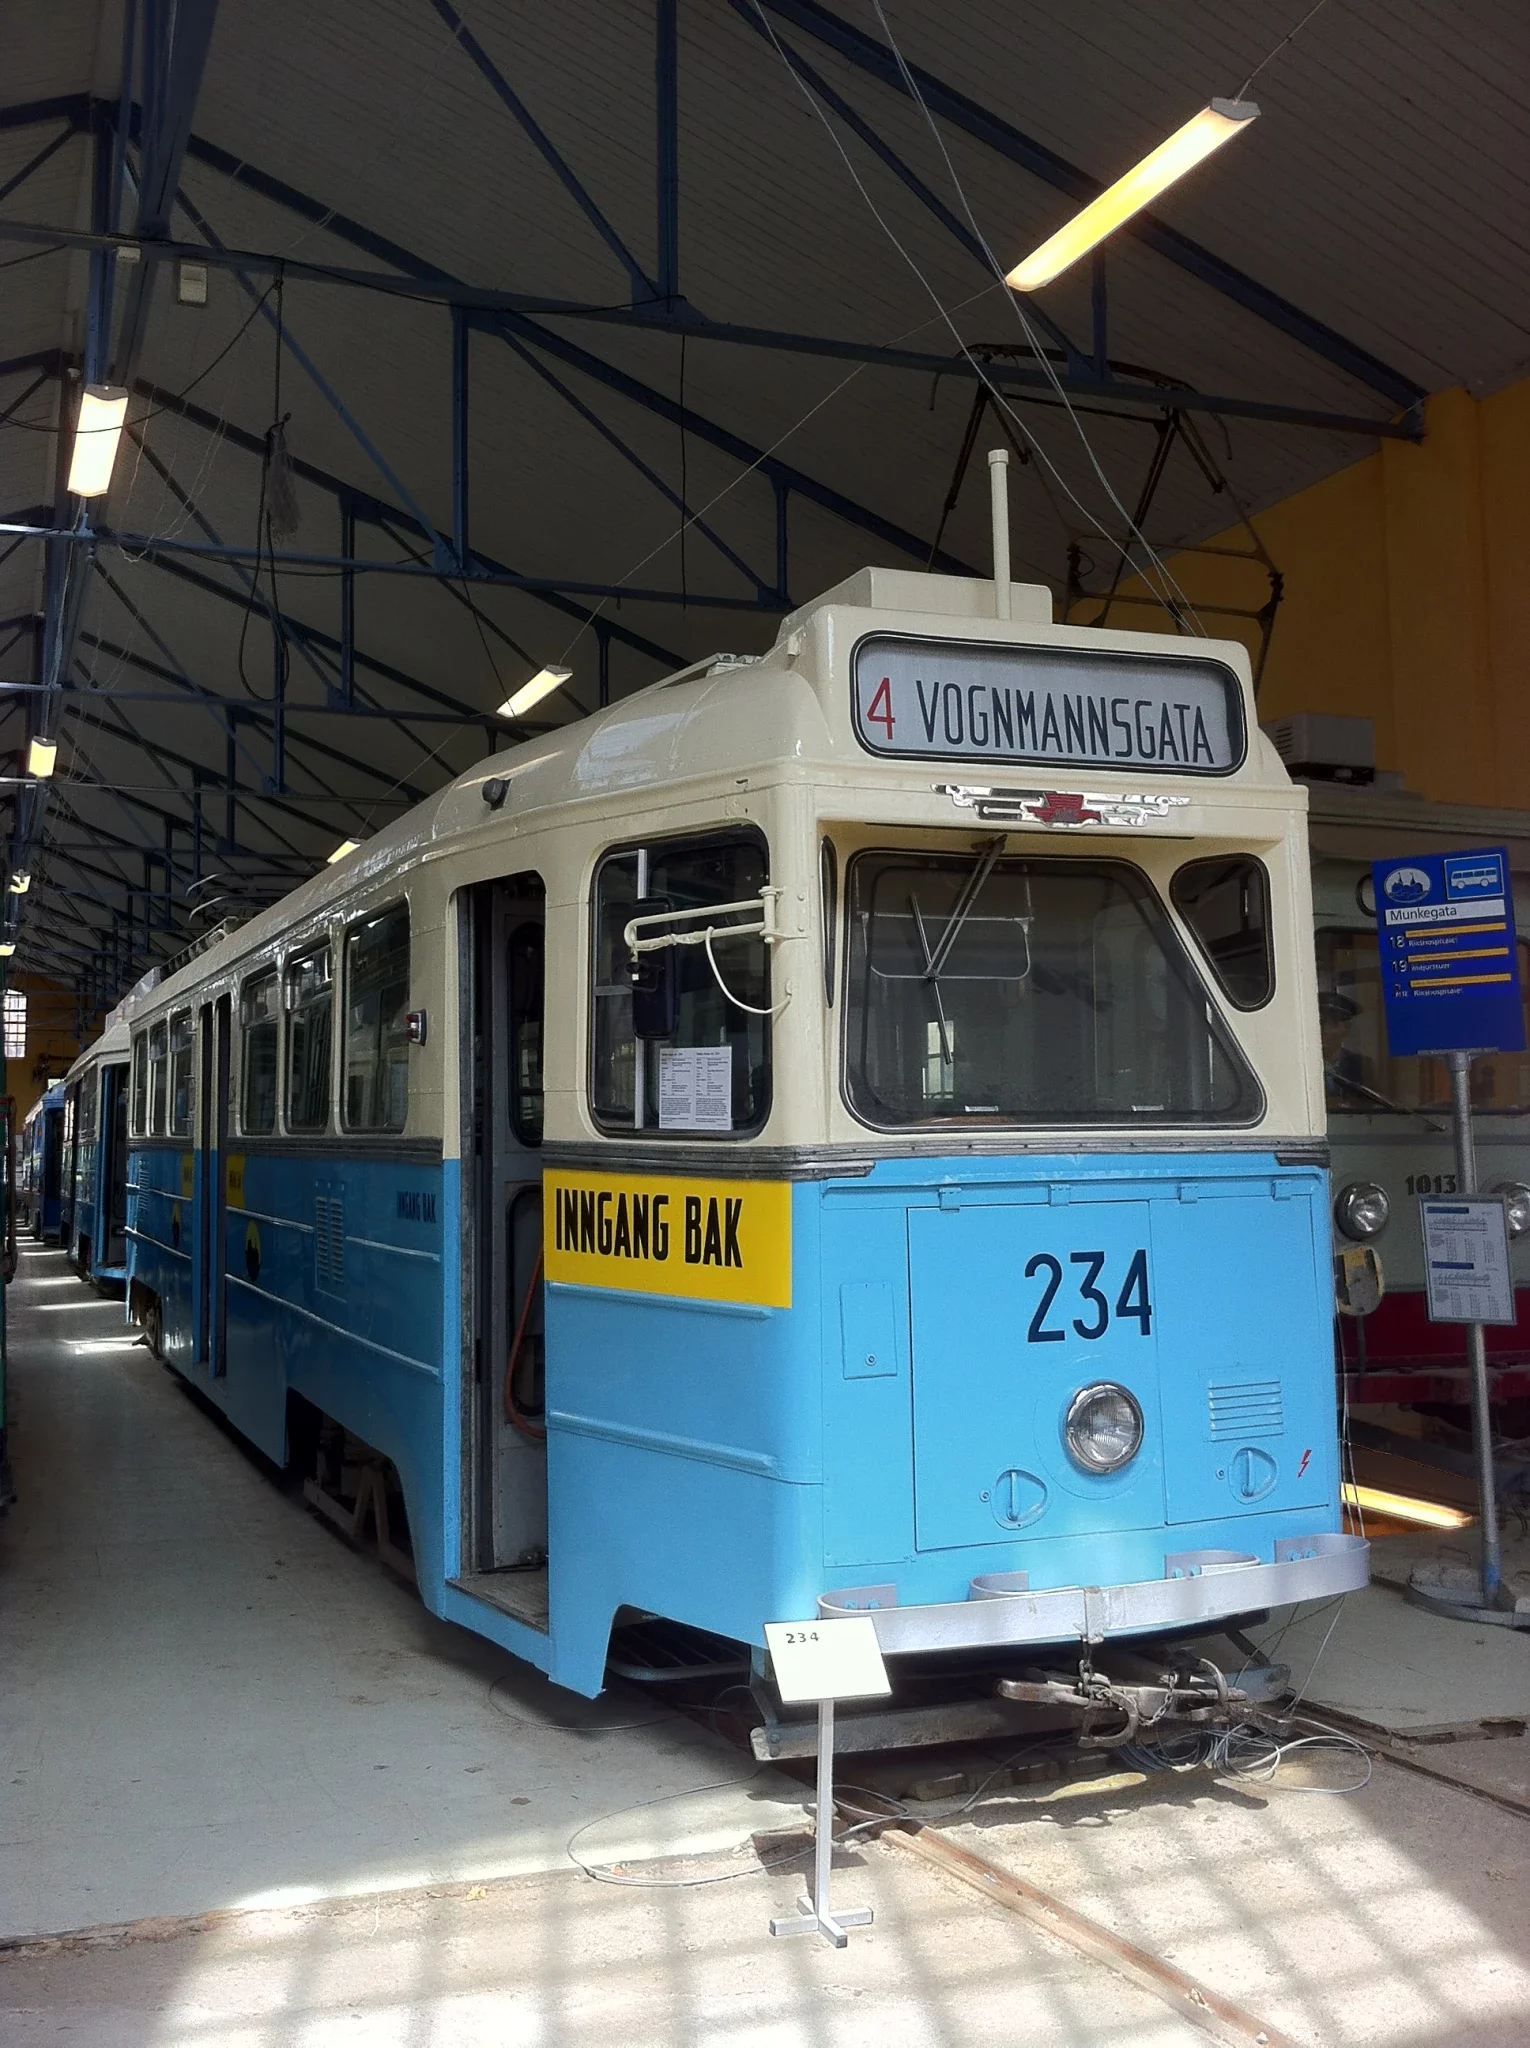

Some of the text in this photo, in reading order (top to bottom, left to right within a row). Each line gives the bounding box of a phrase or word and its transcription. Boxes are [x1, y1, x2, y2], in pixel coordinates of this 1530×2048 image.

[867, 677, 1215, 764] 4 VOGNMANNSGATA
[1390, 905, 1457, 921] Munkegata
[1389, 935, 1405, 948] 18
[1392, 960, 1408, 972] 19
[1405, 1174, 1456, 1196] 1013
[556, 1187, 743, 1268] INNGANG BAK
[1025, 1249, 1152, 1343] 234
[785, 1631, 820, 1644] 234
